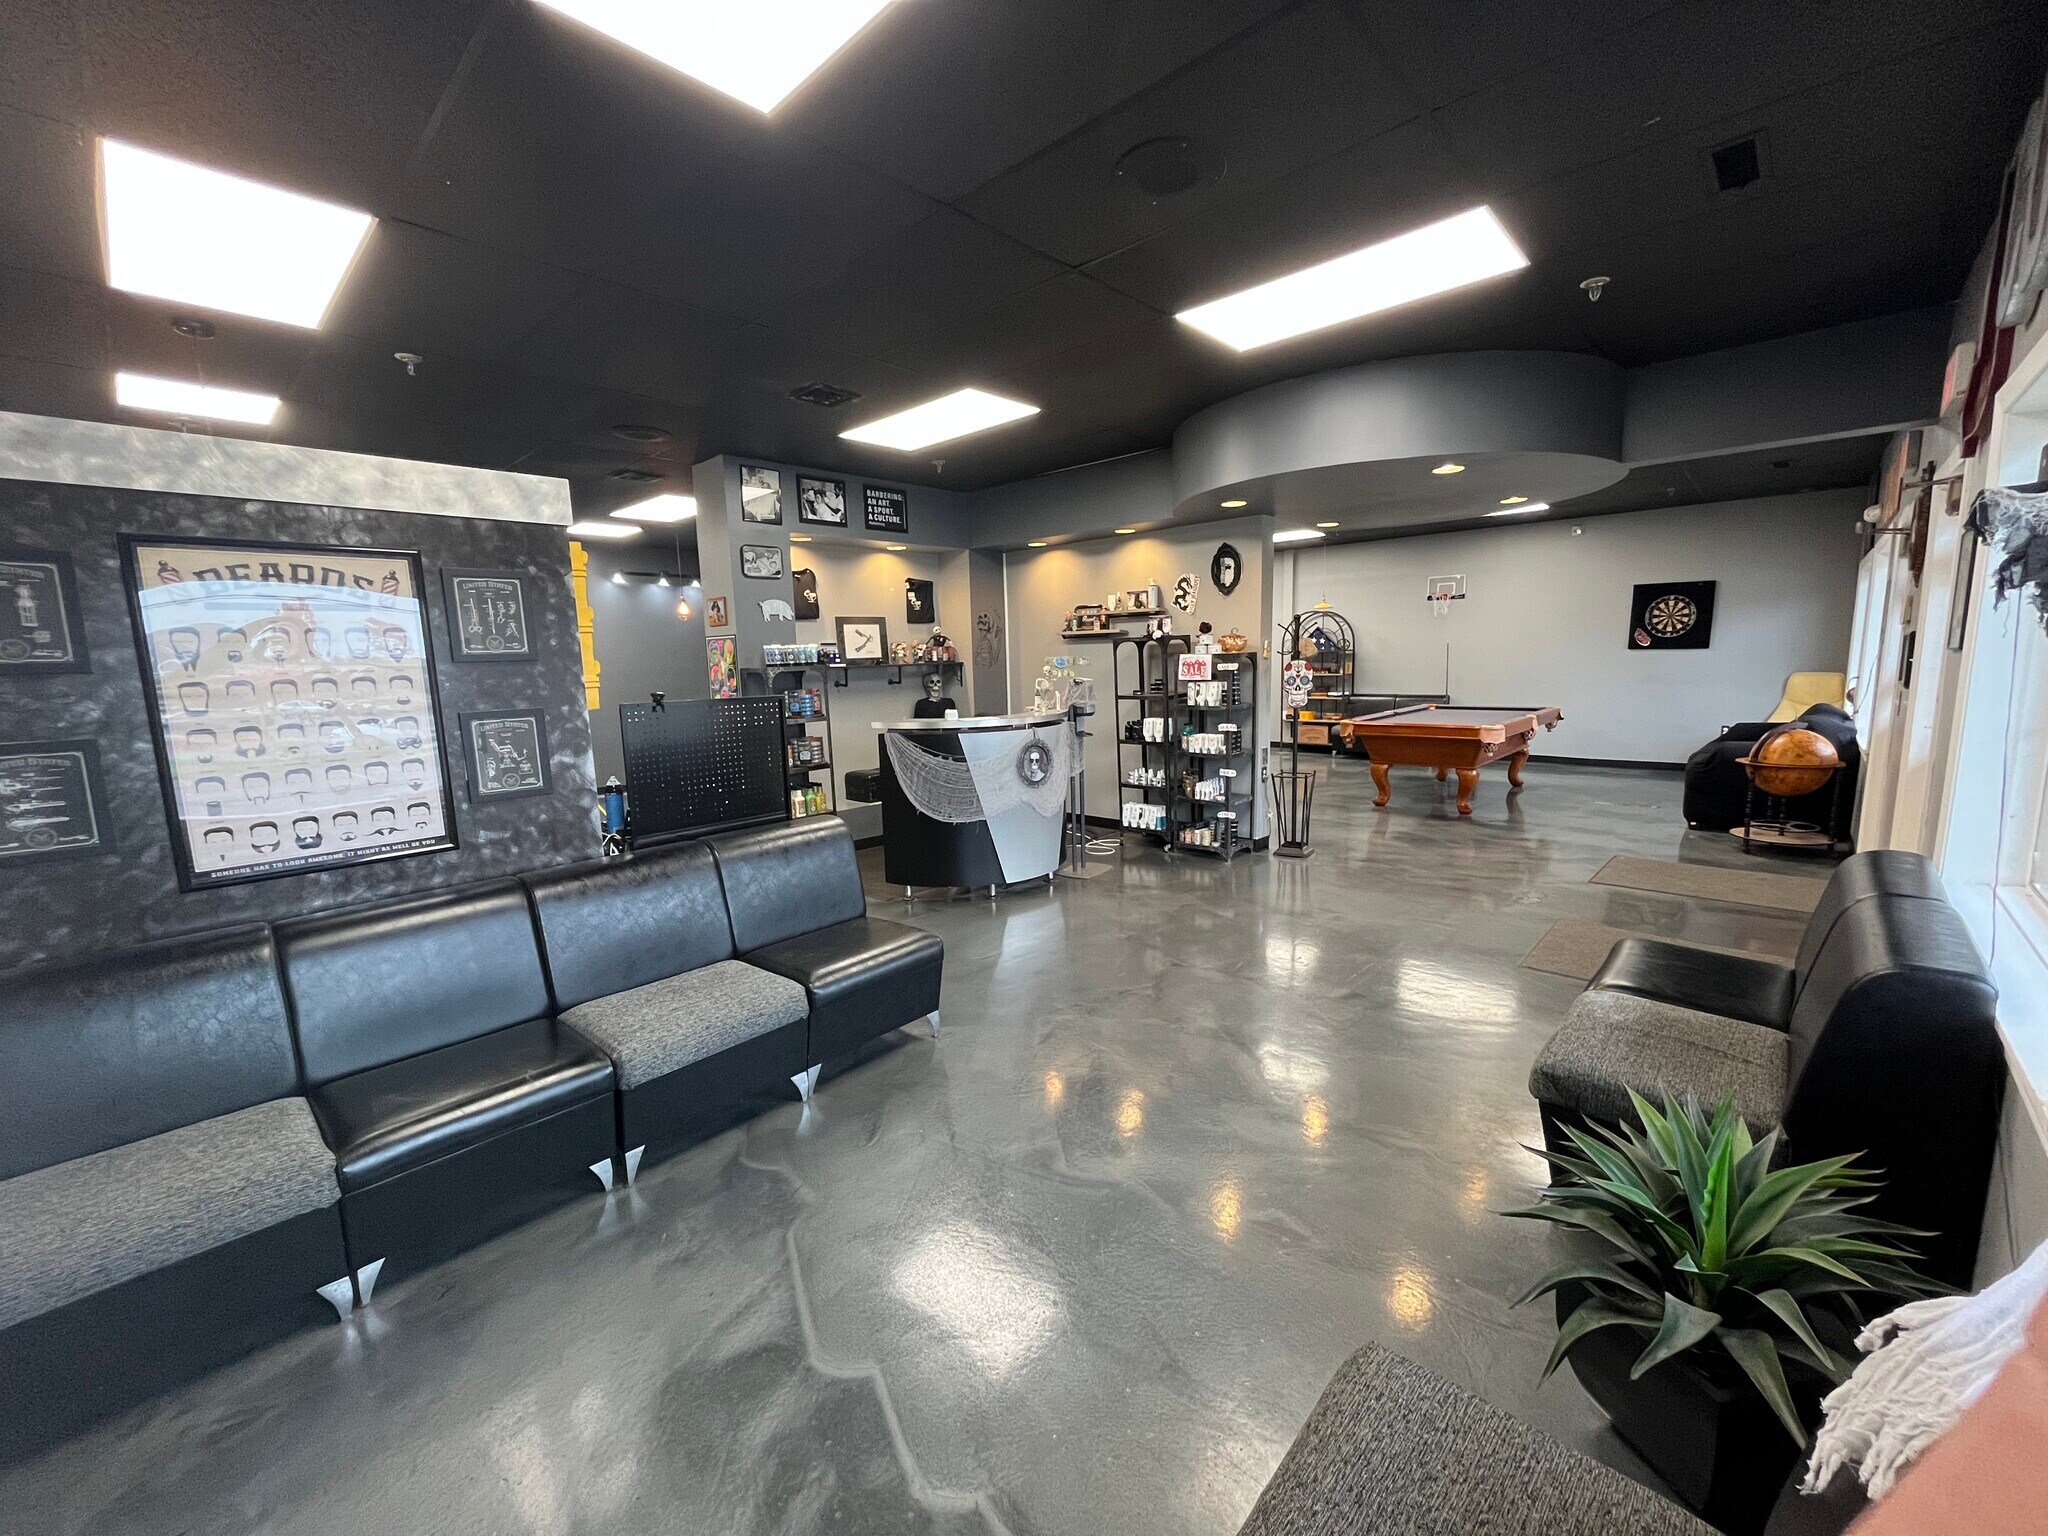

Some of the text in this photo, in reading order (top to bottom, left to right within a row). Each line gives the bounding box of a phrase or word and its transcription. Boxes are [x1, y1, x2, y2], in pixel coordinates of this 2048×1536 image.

[878, 499, 891, 507] ART.
[874, 506, 895, 515] SPORT.
[874, 514, 902, 524] CULTURE.
[463, 582, 487, 590] UNITED
[488, 581, 512, 590] STATES
[1182, 664, 1206, 678] SALE
[480, 723, 503, 732] UNITED
[504, 721, 529, 729] STATES
[211, 867, 251, 878] SOMEONE
[253, 864, 270, 872] HAS
[285, 858, 306, 867] LOOK
[357, 847, 379, 856] MIGHT
[392, 842, 409, 850] WELL
